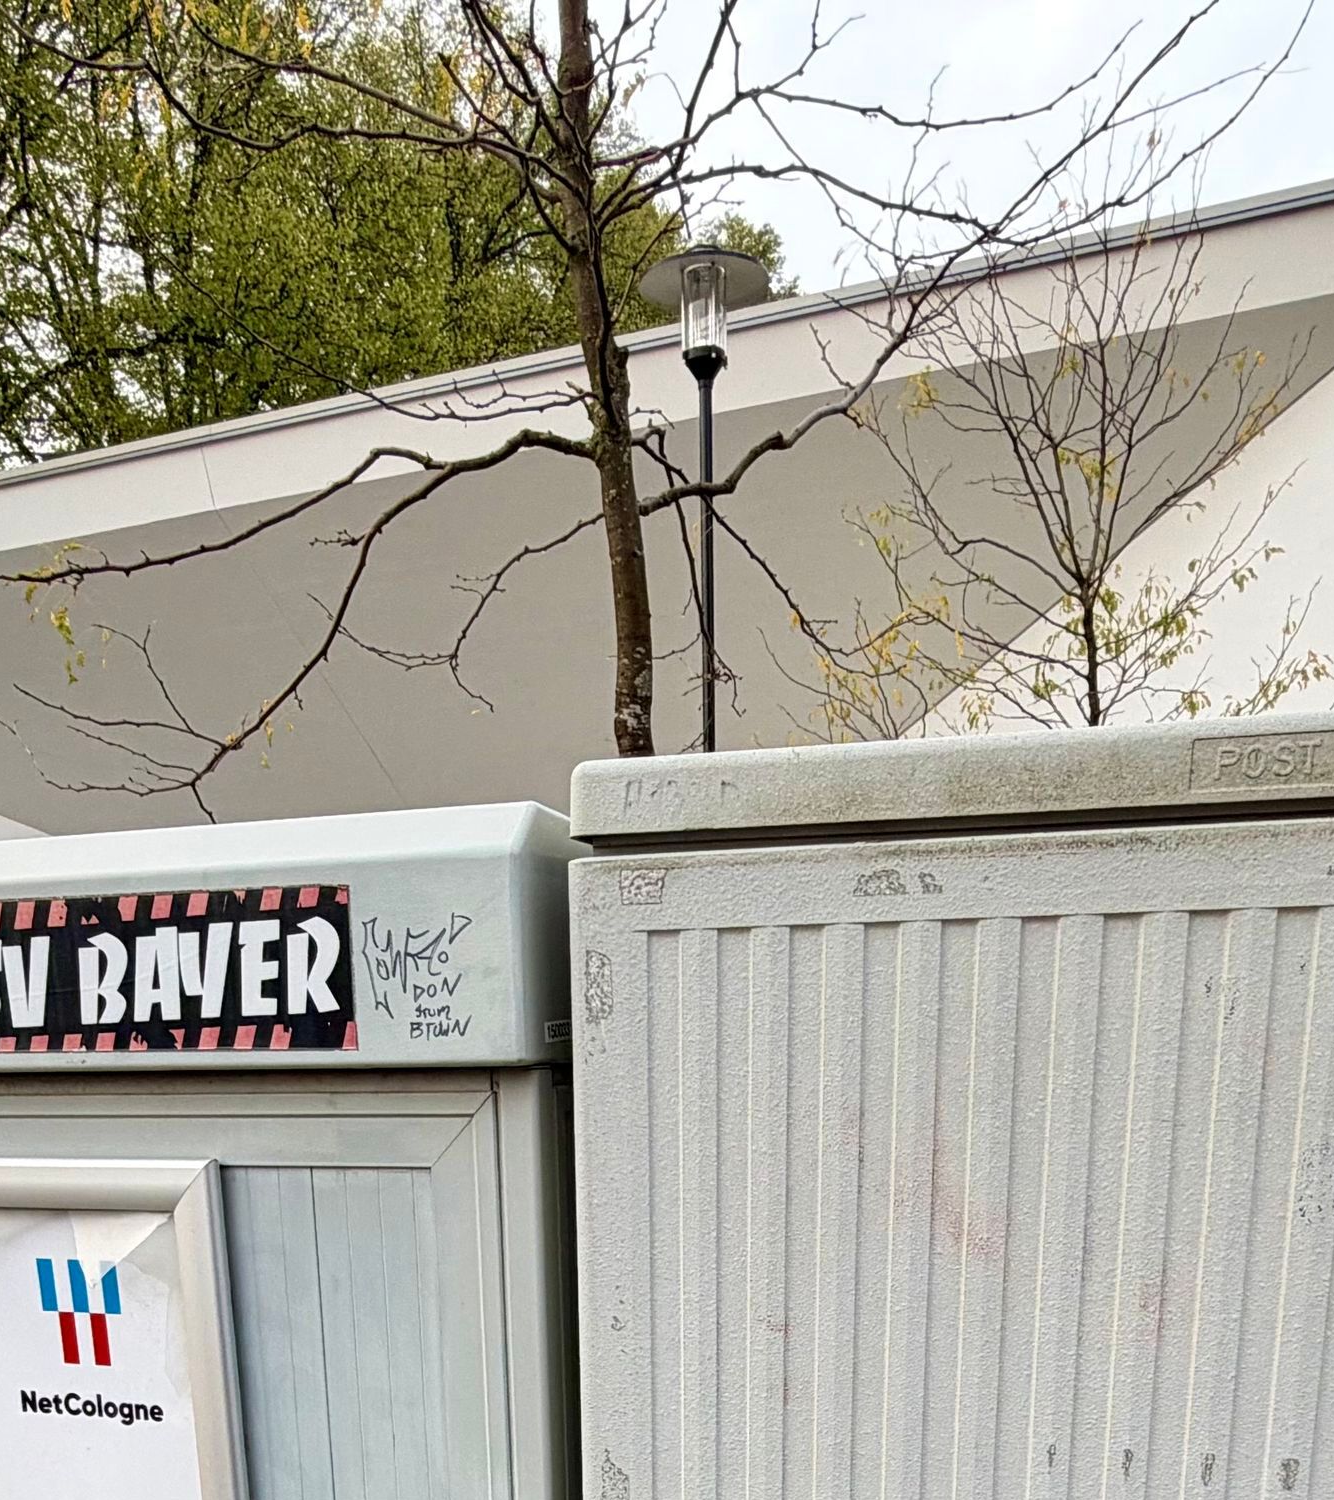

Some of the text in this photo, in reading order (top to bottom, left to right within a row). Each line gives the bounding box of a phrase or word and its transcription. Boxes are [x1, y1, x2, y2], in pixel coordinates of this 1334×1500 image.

[1216, 739, 1324, 781] POST
[78, 916, 340, 1025] BAYER
[413, 973, 462, 1003] DON
[20, 1390, 164, 1426] NetCologne
